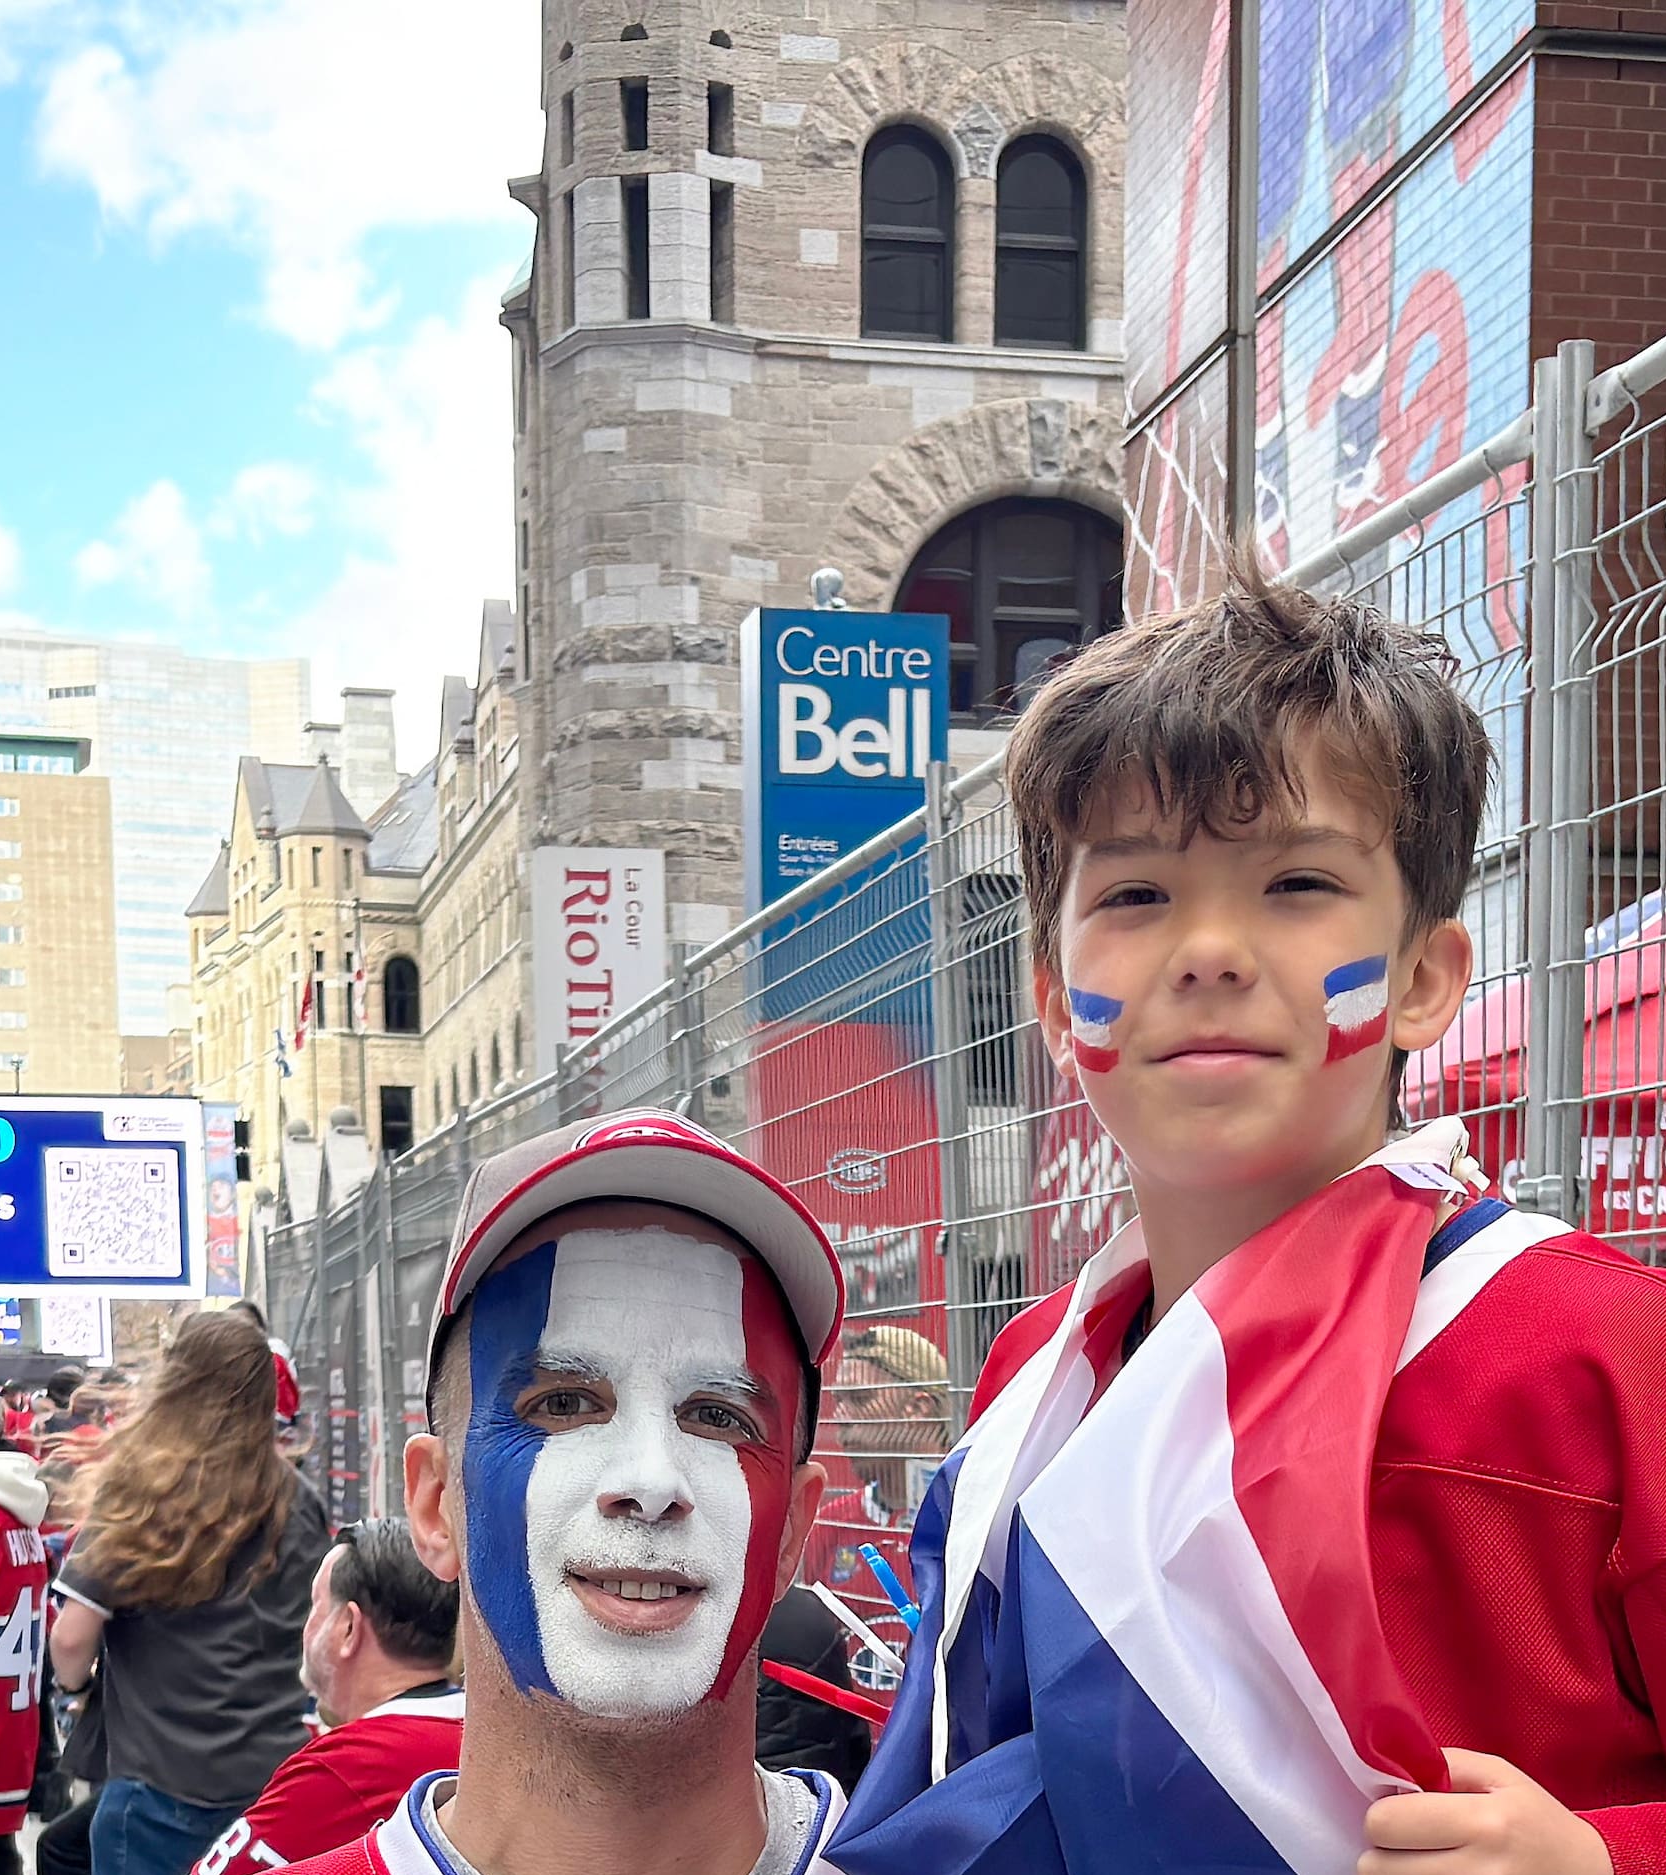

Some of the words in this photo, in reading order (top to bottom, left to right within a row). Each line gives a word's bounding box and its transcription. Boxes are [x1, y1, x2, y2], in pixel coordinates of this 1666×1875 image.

[776, 627, 931, 679] Centre
[779, 683, 930, 777] Bell
[779, 834, 839, 852] Entrées
[624, 868, 642, 892] La
[561, 867, 611, 966] Rio
[625, 899, 643, 949] Cour
